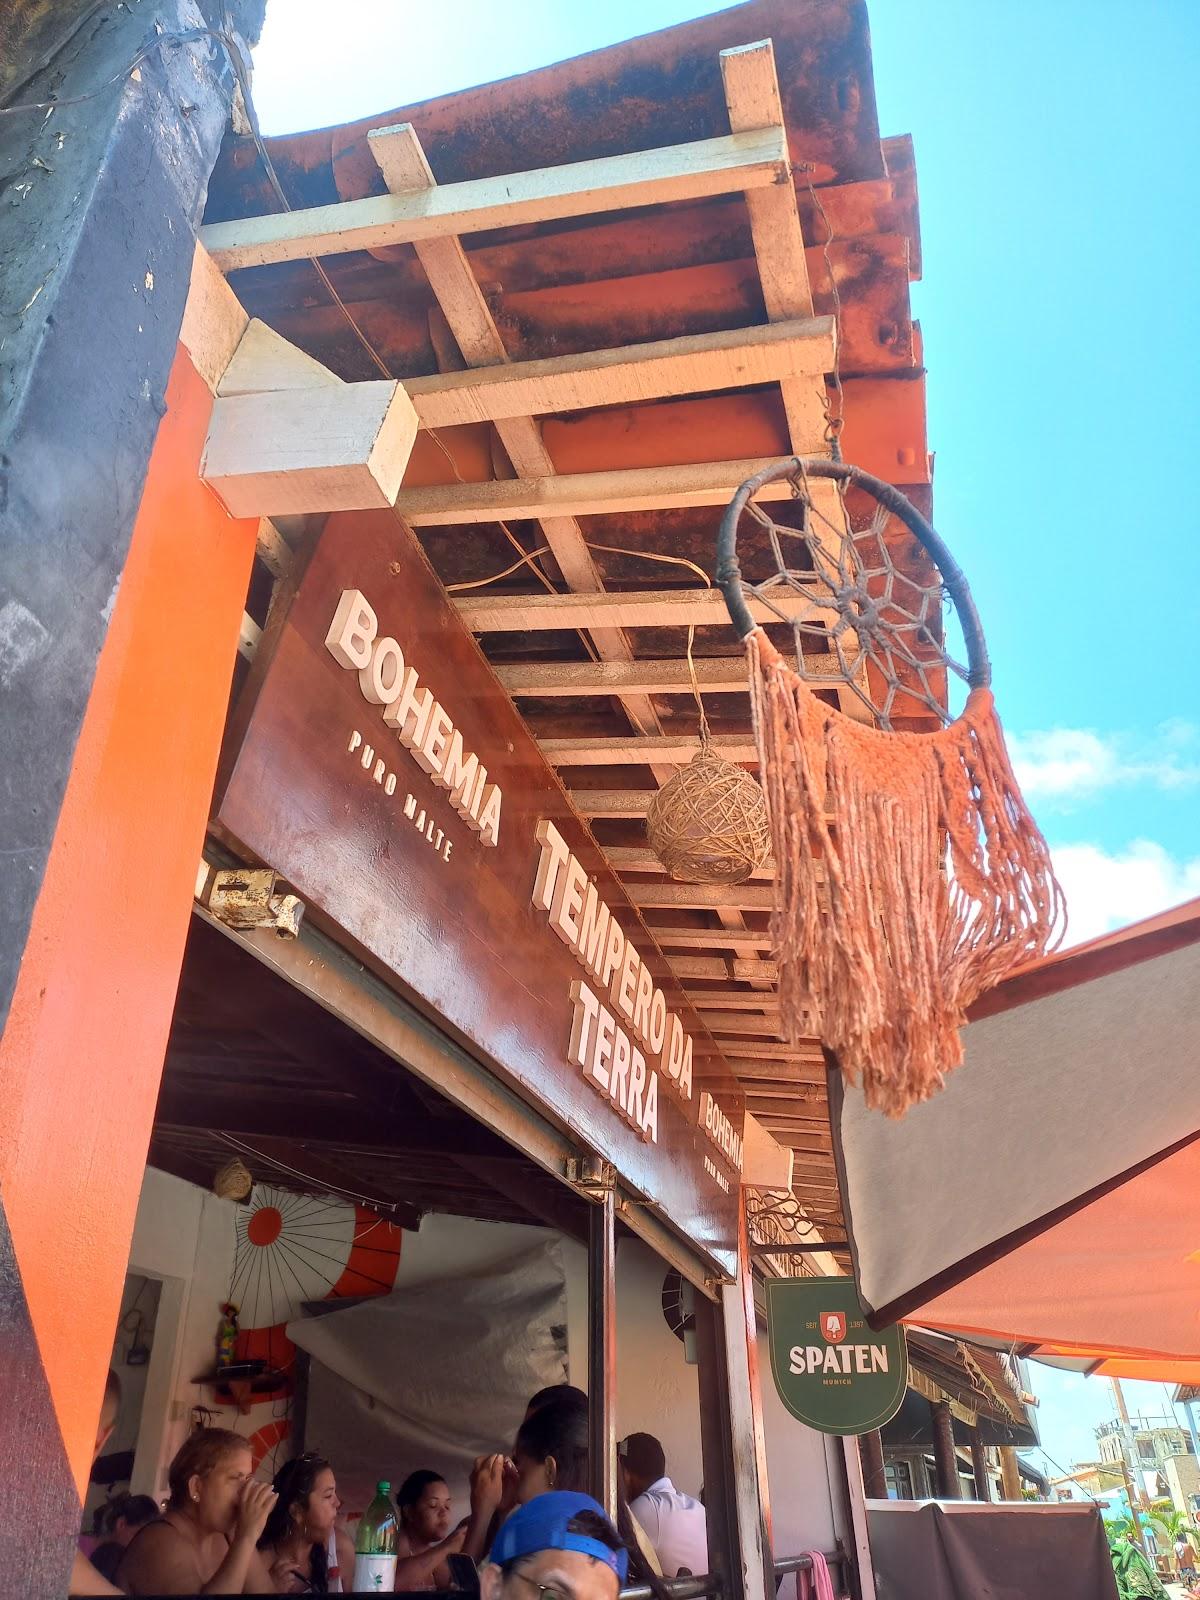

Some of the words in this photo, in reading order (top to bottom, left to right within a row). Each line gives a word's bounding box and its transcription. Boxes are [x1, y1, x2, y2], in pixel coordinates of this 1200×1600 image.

[325, 589, 502, 847] BOHEMIA
[348, 730, 397, 796] PURO
[403, 793, 453, 863] MALTE
[532, 819, 667, 1055] TEMPERO
[660, 1012, 693, 1100] DA
[568, 978, 658, 1144] TERRA
[698, 1092, 744, 1175] BOHEMIA
[789, 1344, 889, 1375] SPATEN
